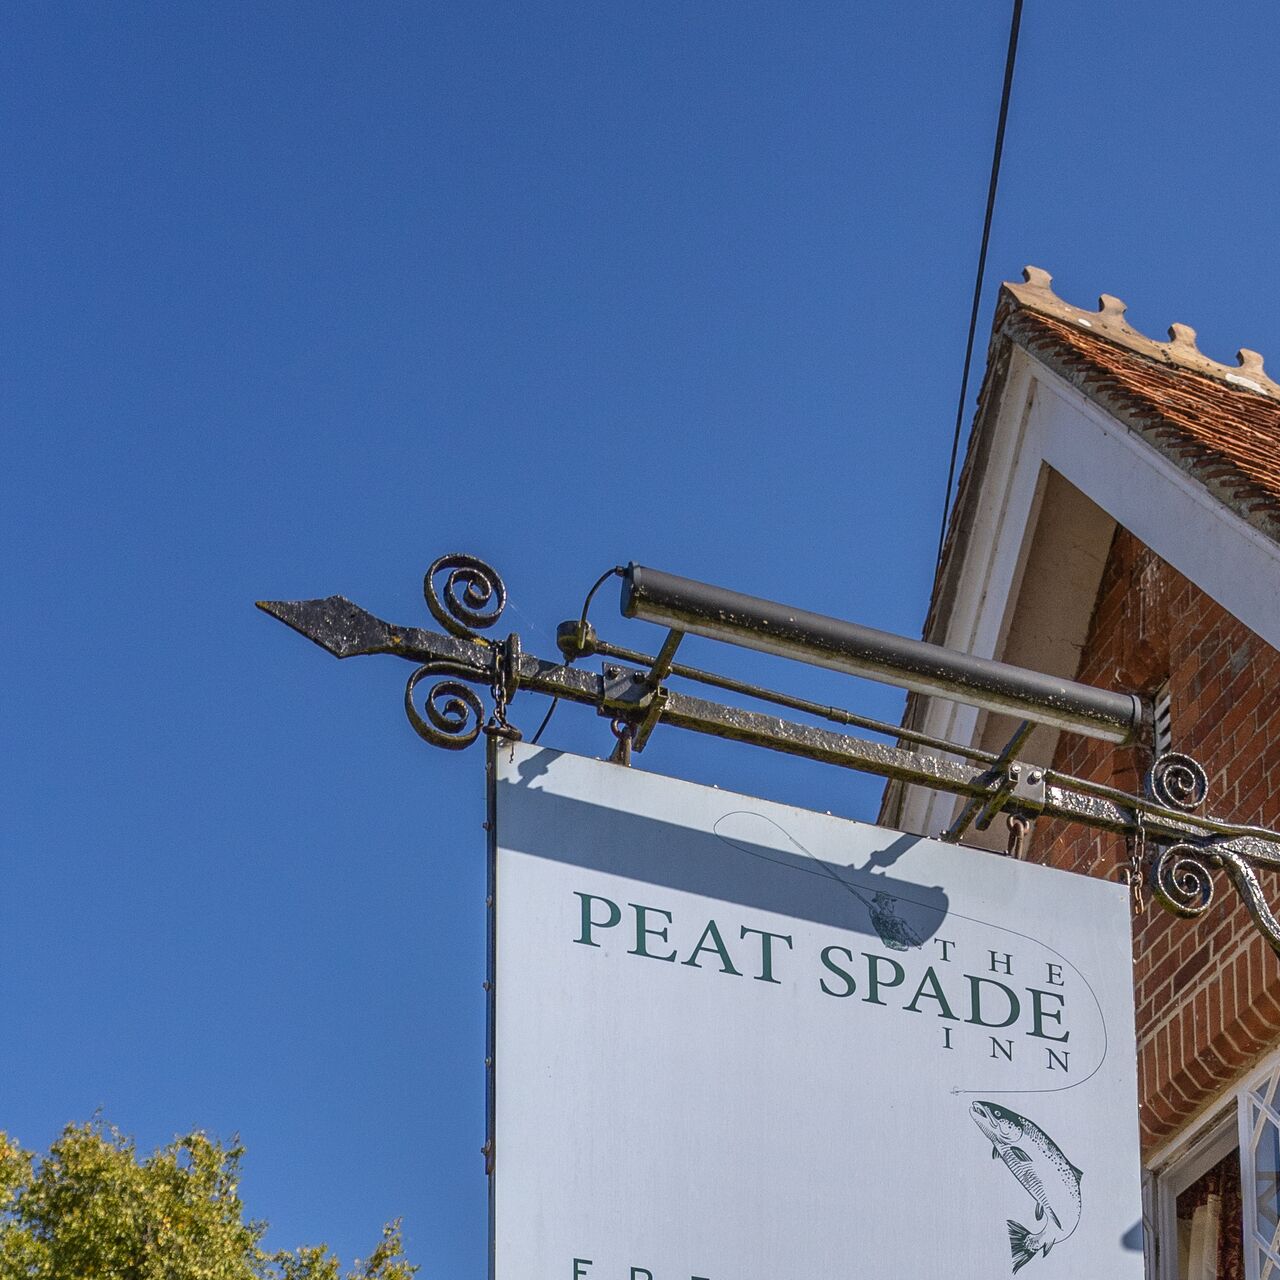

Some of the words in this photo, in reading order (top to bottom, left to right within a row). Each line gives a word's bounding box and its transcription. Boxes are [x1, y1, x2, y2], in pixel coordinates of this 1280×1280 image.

[572, 891, 793, 984] PEAT
[818, 945, 1070, 1044] SPADE
[934, 937, 1064, 987] THE
[942, 1026, 1070, 1073] INN
